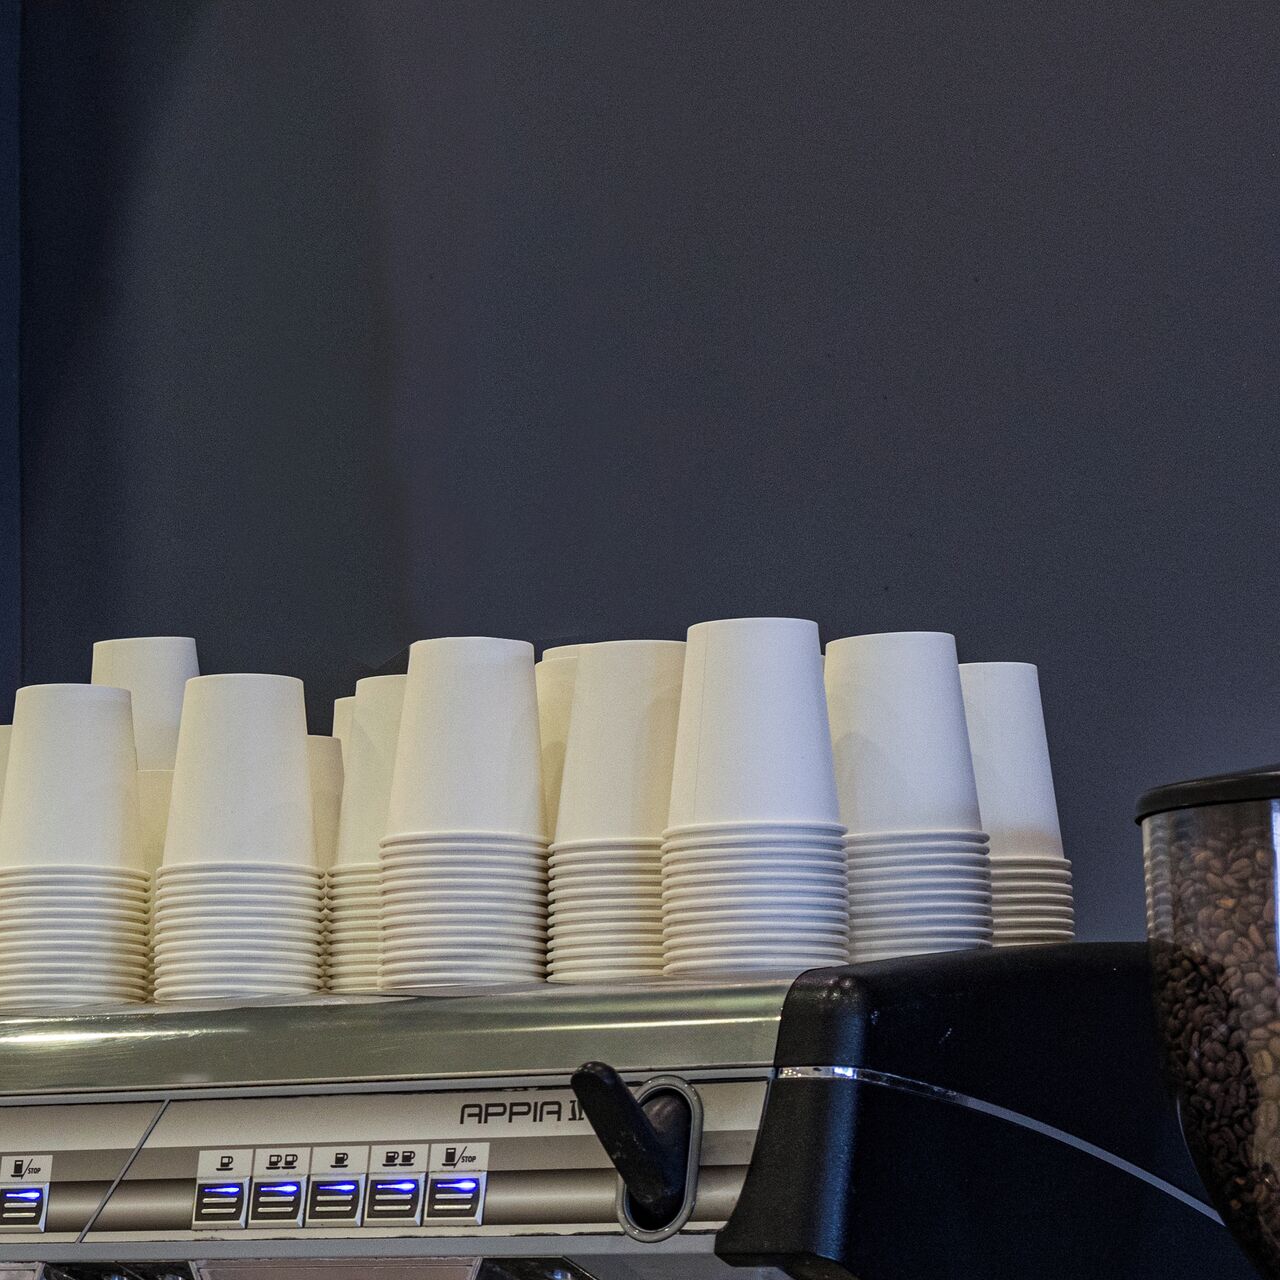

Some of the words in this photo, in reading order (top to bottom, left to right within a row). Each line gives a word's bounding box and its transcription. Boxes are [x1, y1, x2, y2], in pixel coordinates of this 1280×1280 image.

[460, 1101, 562, 1124] APPIA
[461, 1155, 477, 1163] STOP
[28, 1167, 41, 1175] STOP
